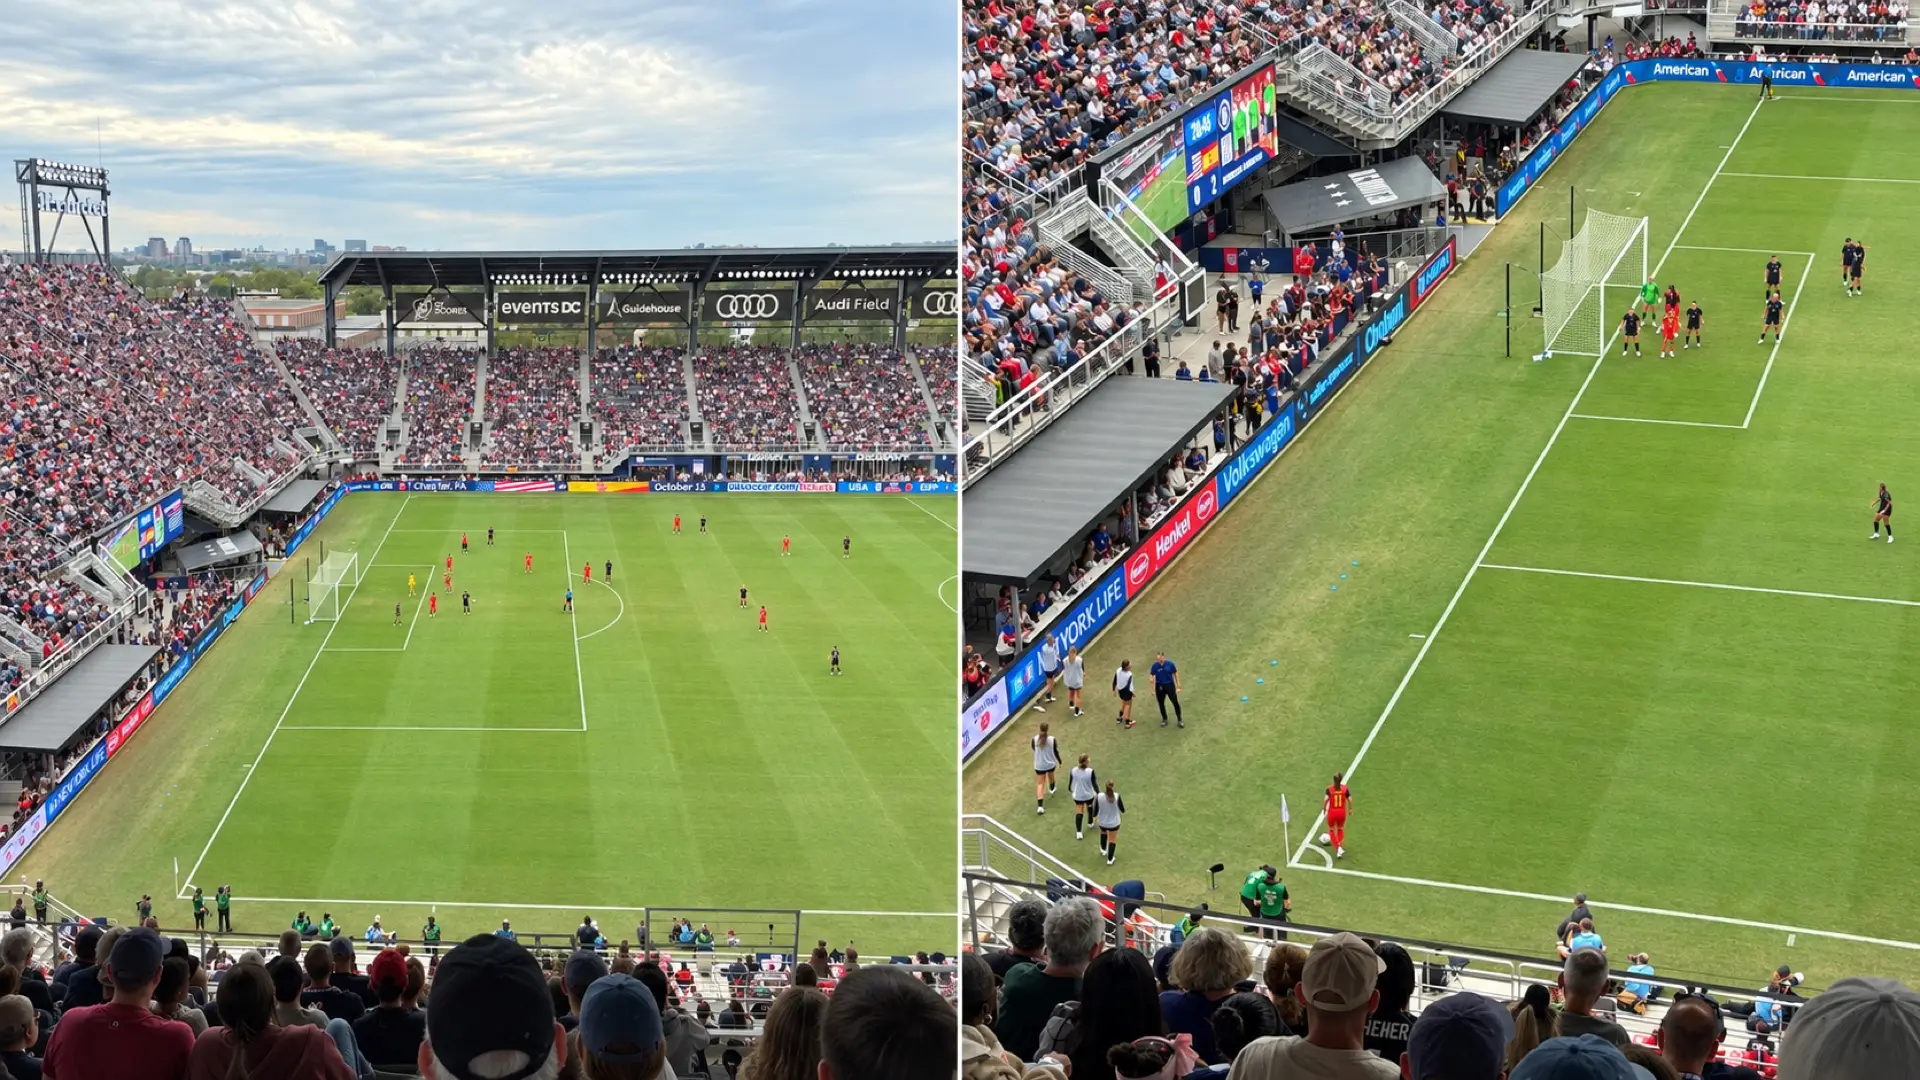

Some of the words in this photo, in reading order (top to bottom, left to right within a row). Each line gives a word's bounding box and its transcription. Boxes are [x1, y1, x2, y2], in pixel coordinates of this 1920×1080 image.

[1654, 63, 1709, 77] American
[1749, 66, 1806, 79] Arican
[1847, 69, 1906, 82] American
[1193, 185, 1201, 206] 0
[1210, 174, 1217, 195] 2
[561, 302, 581, 314] DC
[622, 303, 682, 313] Guidehouse
[814, 298, 850, 311] Audi
[854, 298, 890, 311] Field
[1364, 294, 1405, 354] Chobani
[1223, 415, 1291, 493] Volkswagen
[654, 482, 693, 491] October
[1155, 510, 1191, 561] Henkel
[1060, 602, 1096, 651] YORK
[1097, 577, 1122, 618] LIFE
[1334, 794, 1342, 808] 11
